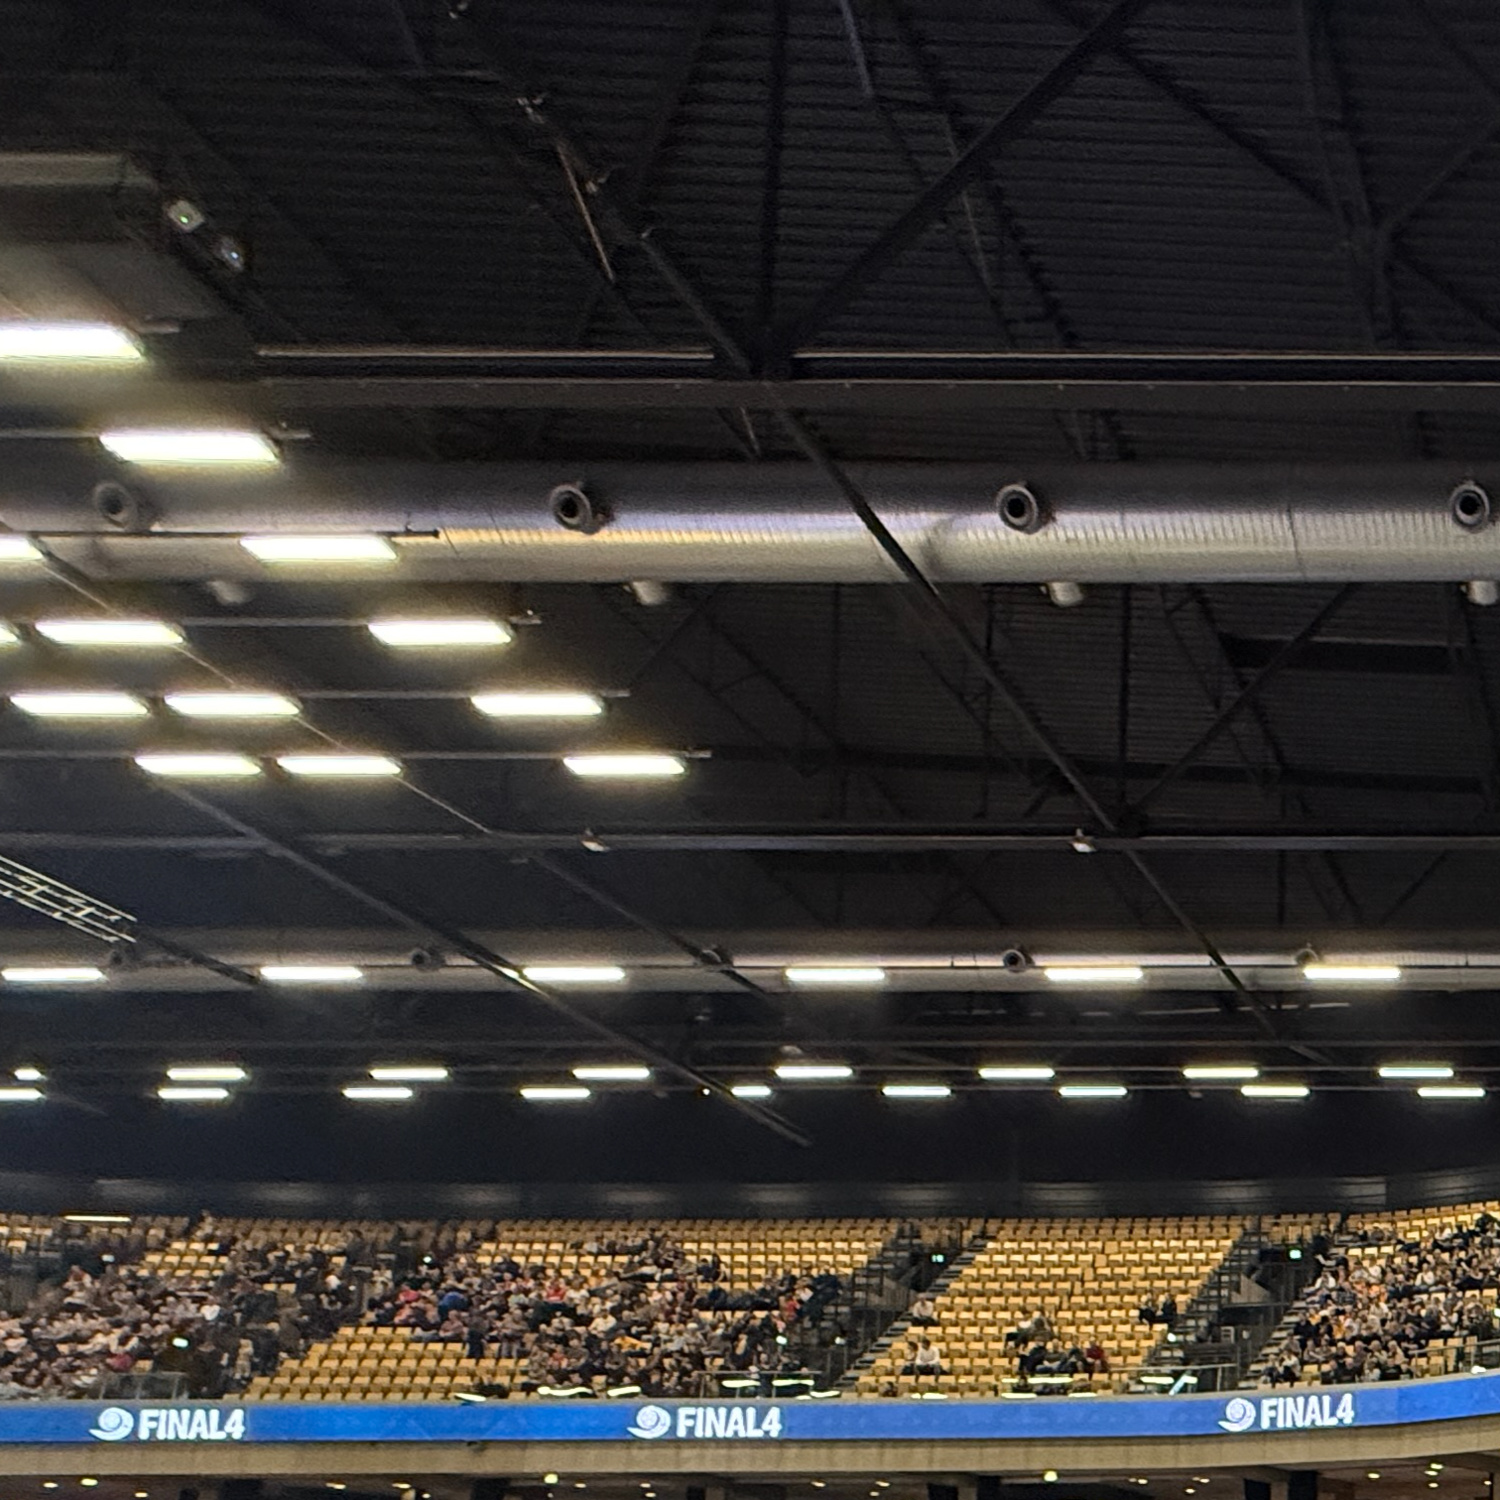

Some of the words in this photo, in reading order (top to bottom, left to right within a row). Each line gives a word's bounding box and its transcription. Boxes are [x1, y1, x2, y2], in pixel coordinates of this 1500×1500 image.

[138, 1408, 245, 1440] FINAL4
[676, 1407, 782, 1438] FINAL4
[1260, 1393, 1355, 1429] FINAL4
